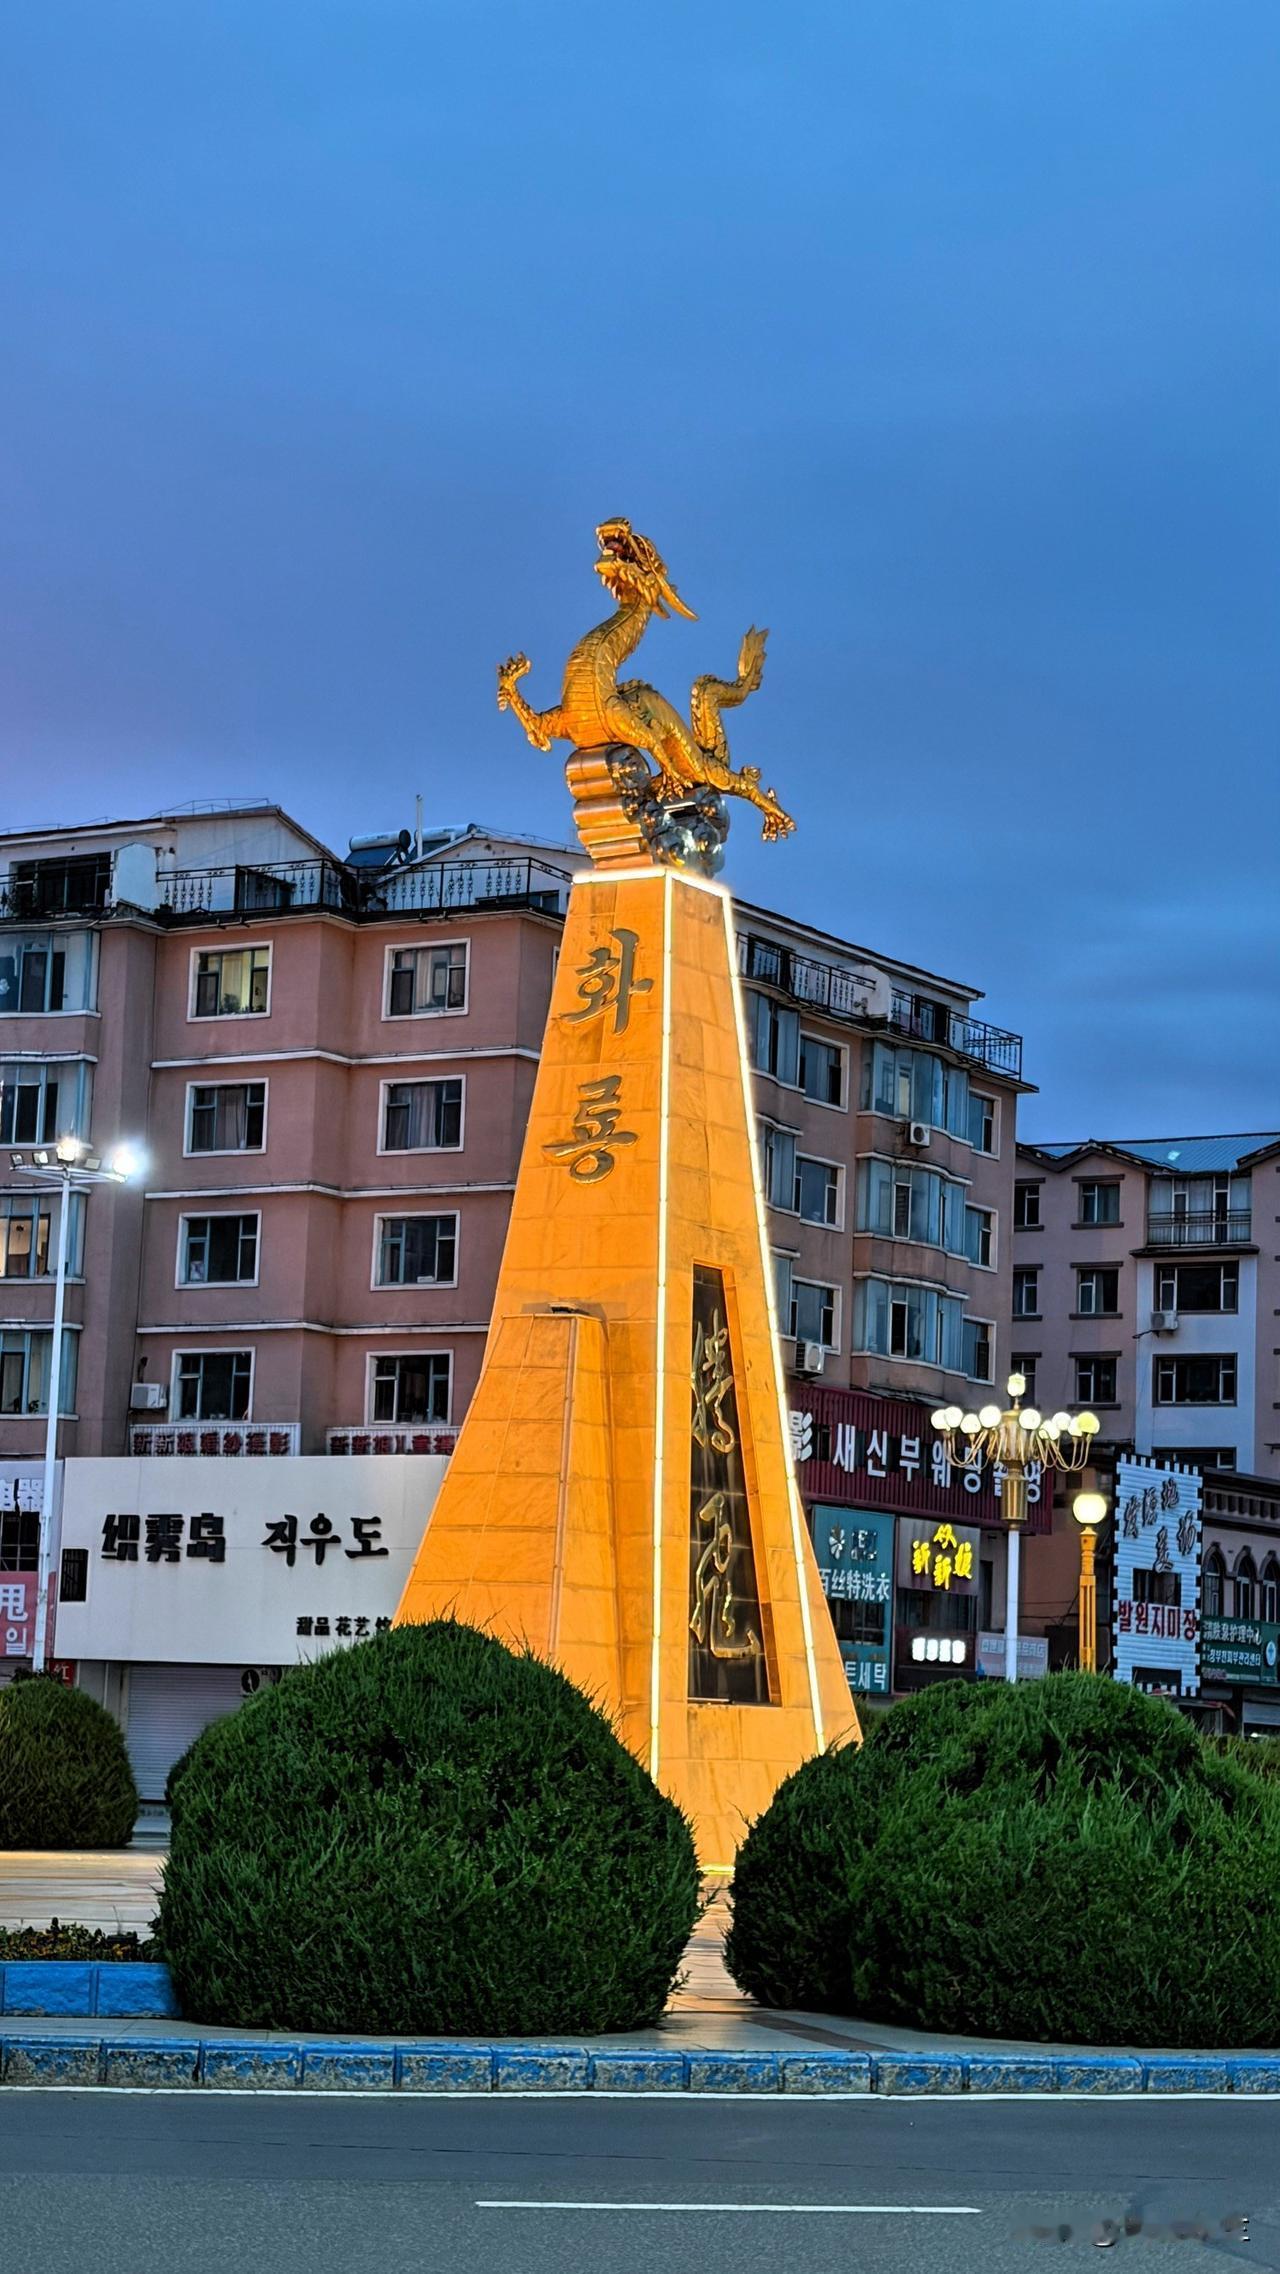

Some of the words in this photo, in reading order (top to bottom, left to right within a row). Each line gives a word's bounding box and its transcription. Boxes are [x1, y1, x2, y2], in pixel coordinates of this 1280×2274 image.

[541, 928, 655, 1184] 화룡
[101, 1513, 226, 1563] 织雾岛
[261, 1513, 390, 1567] 직우도
[1117, 1600, 1197, 1641] 발원지미장
